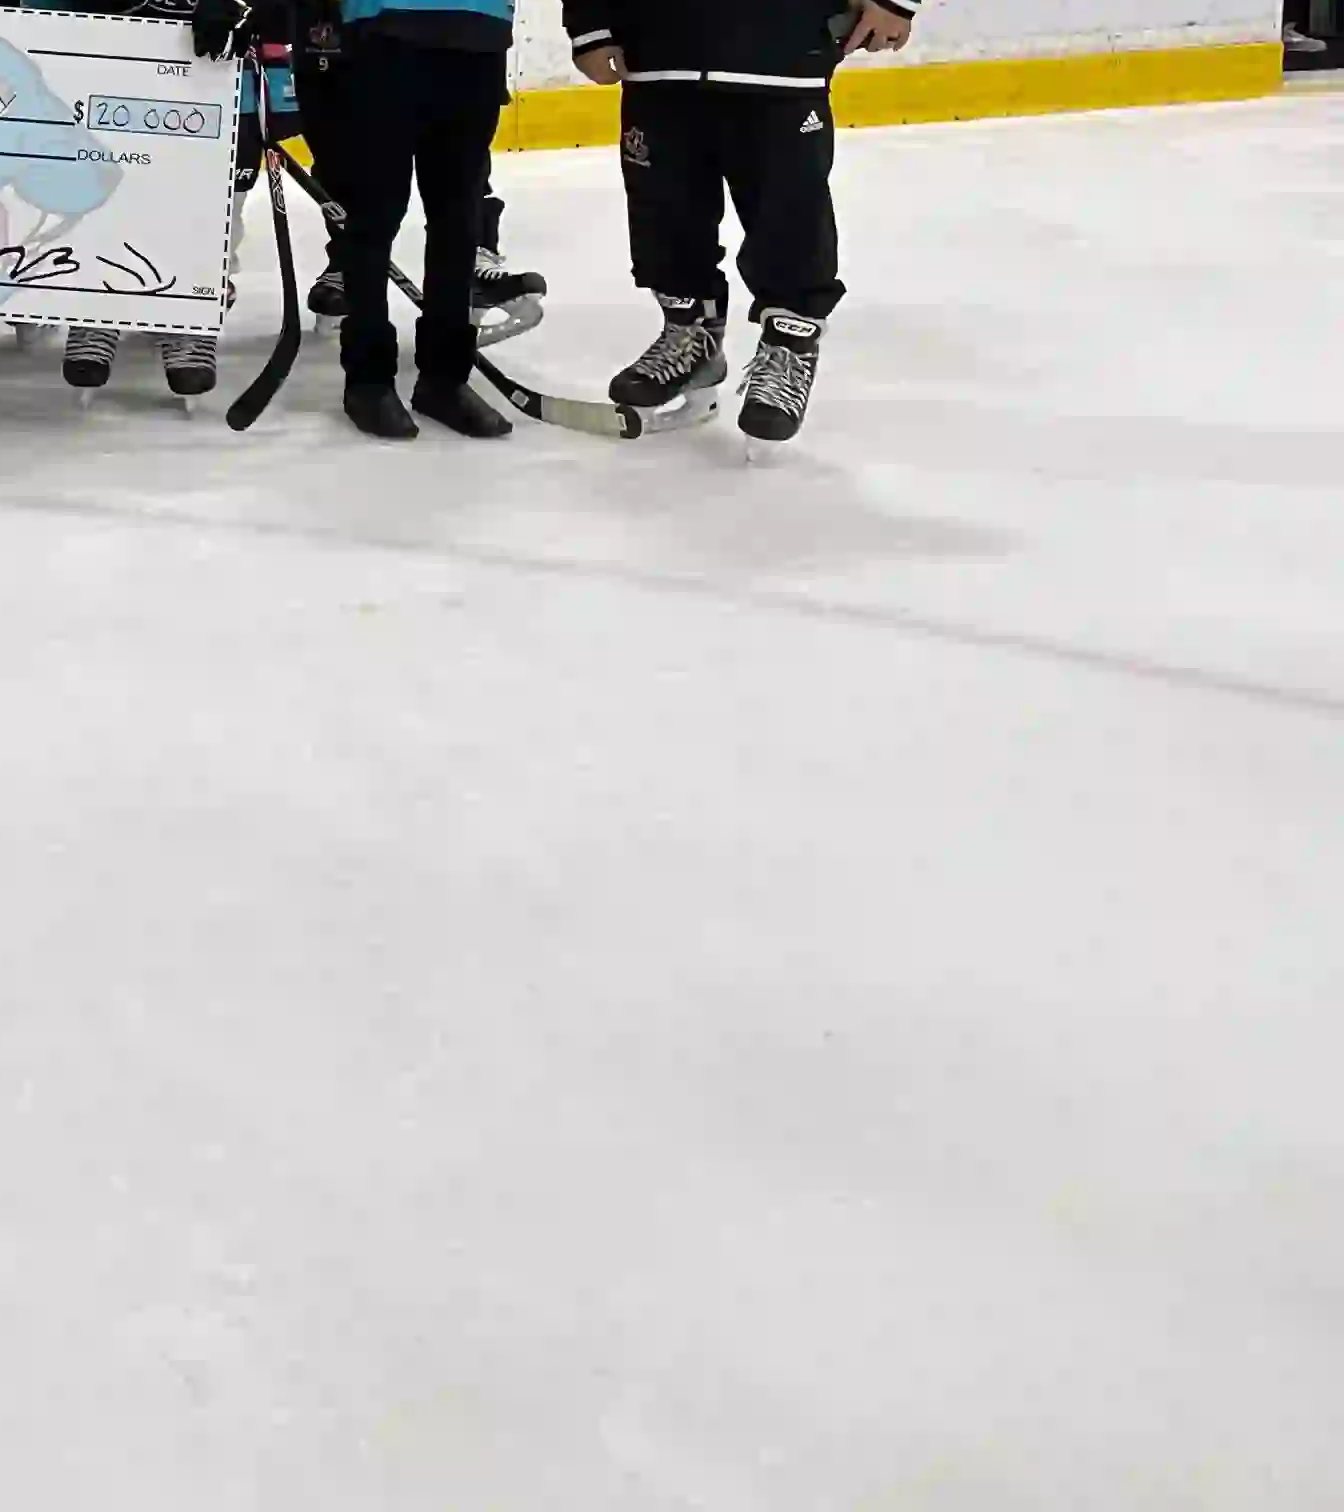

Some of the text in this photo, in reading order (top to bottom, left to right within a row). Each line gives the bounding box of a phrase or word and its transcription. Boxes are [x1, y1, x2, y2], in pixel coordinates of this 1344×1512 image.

[156, 63, 191, 78] DATE
[318, 57, 329, 72] 9
[73, 99, 84, 124] $
[96, 102, 205, 133] 20 000
[76, 148, 152, 166] DOLLARS
[191, 285, 216, 296] SIGN
[775, 319, 814, 334] CCM
